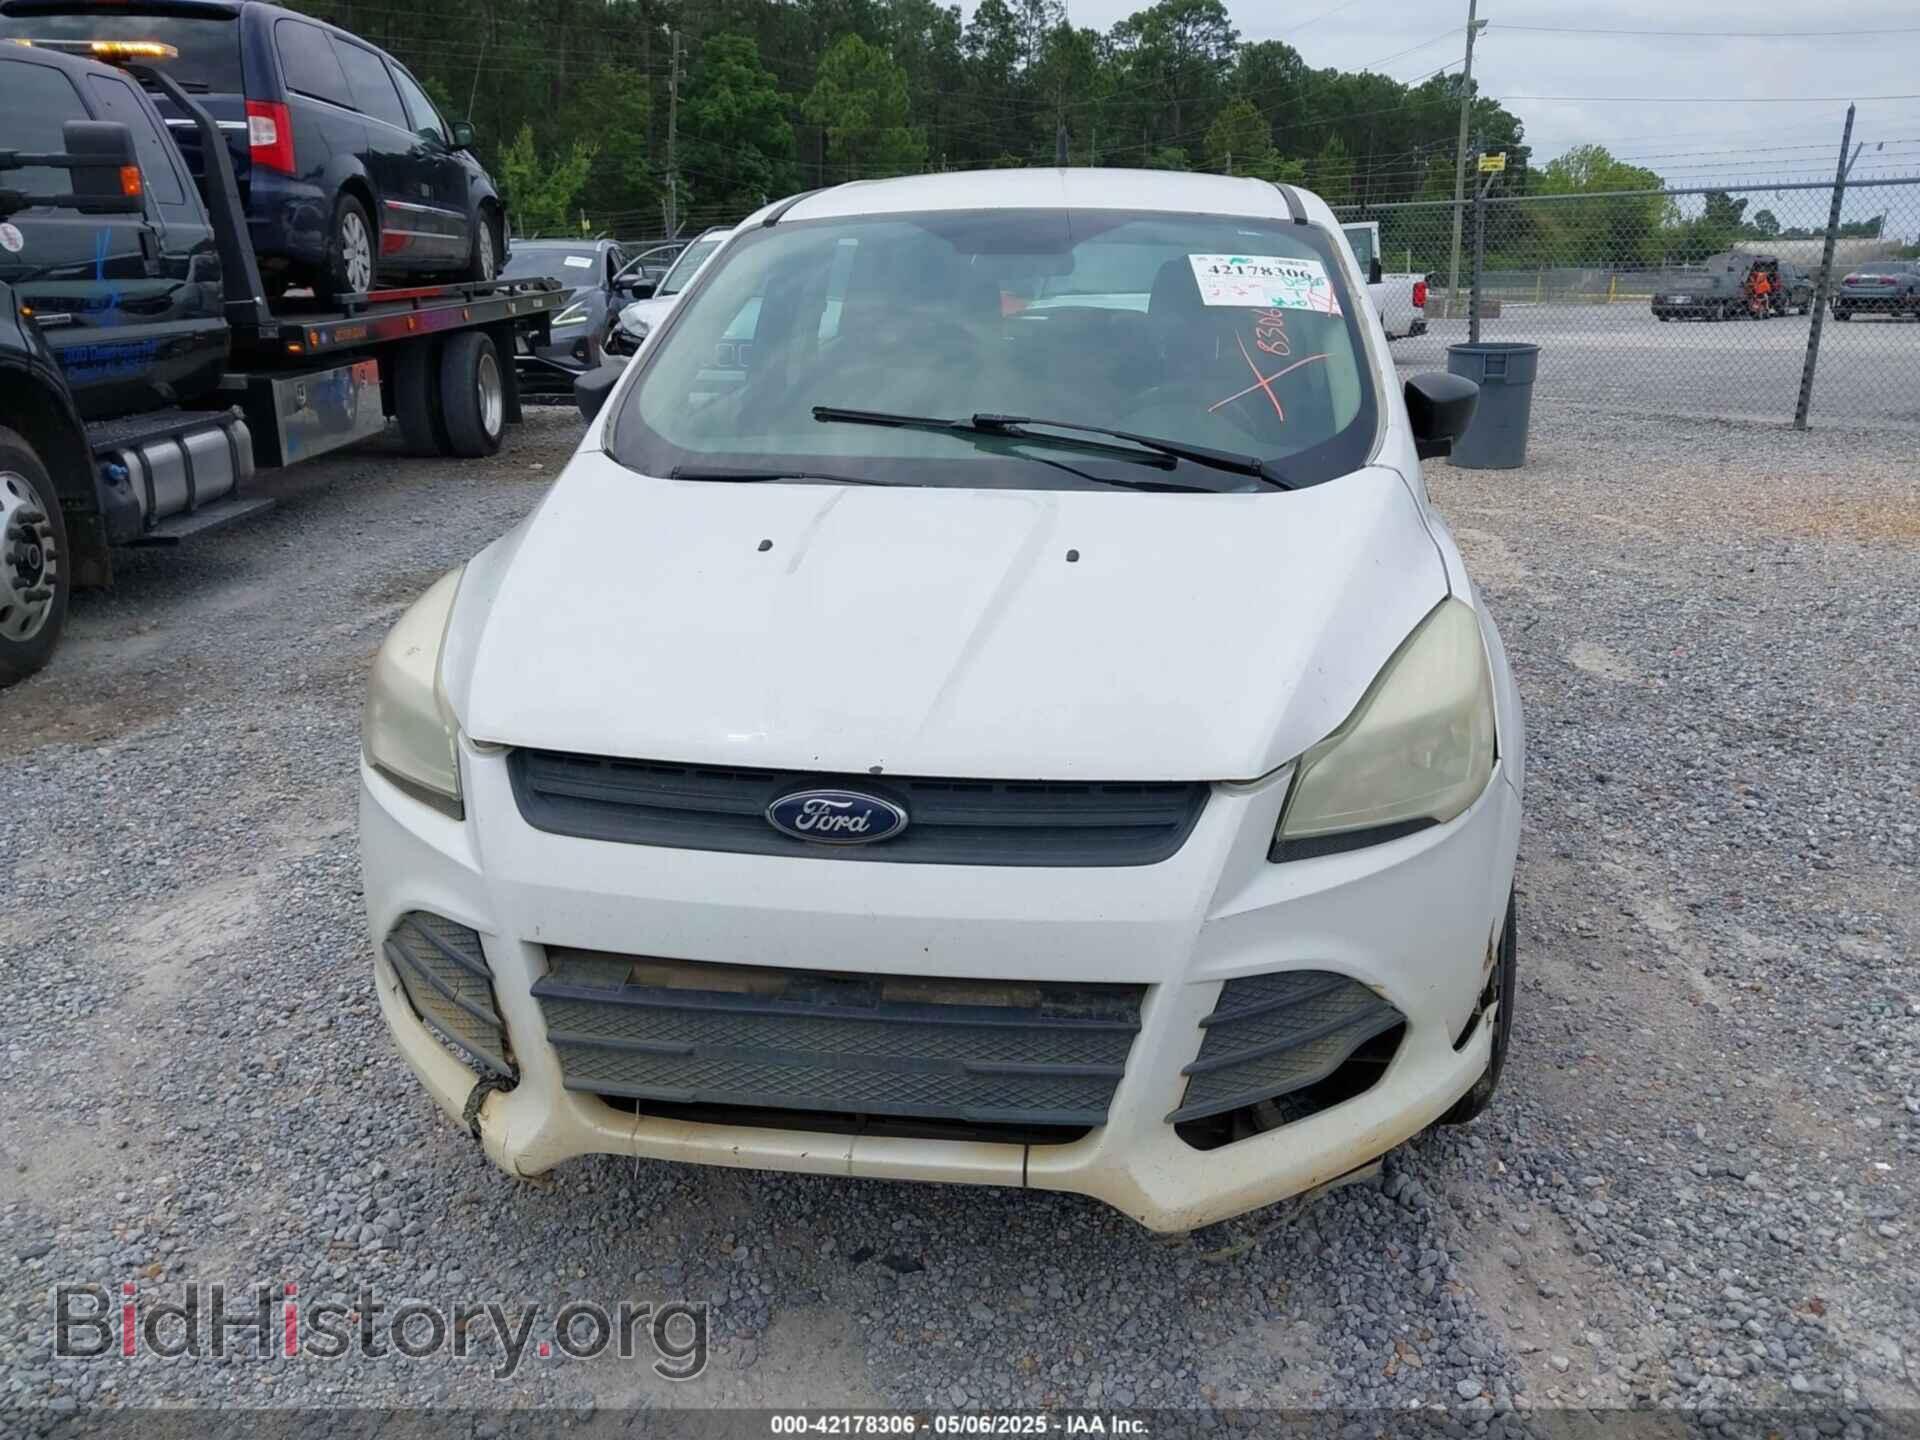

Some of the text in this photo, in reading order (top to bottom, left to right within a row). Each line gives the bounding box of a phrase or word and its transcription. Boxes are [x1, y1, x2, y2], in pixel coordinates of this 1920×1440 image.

[1209, 265, 1312, 280] 42178306
[1254, 308, 1291, 356] 8306
[796, 799, 871, 832] Ford
